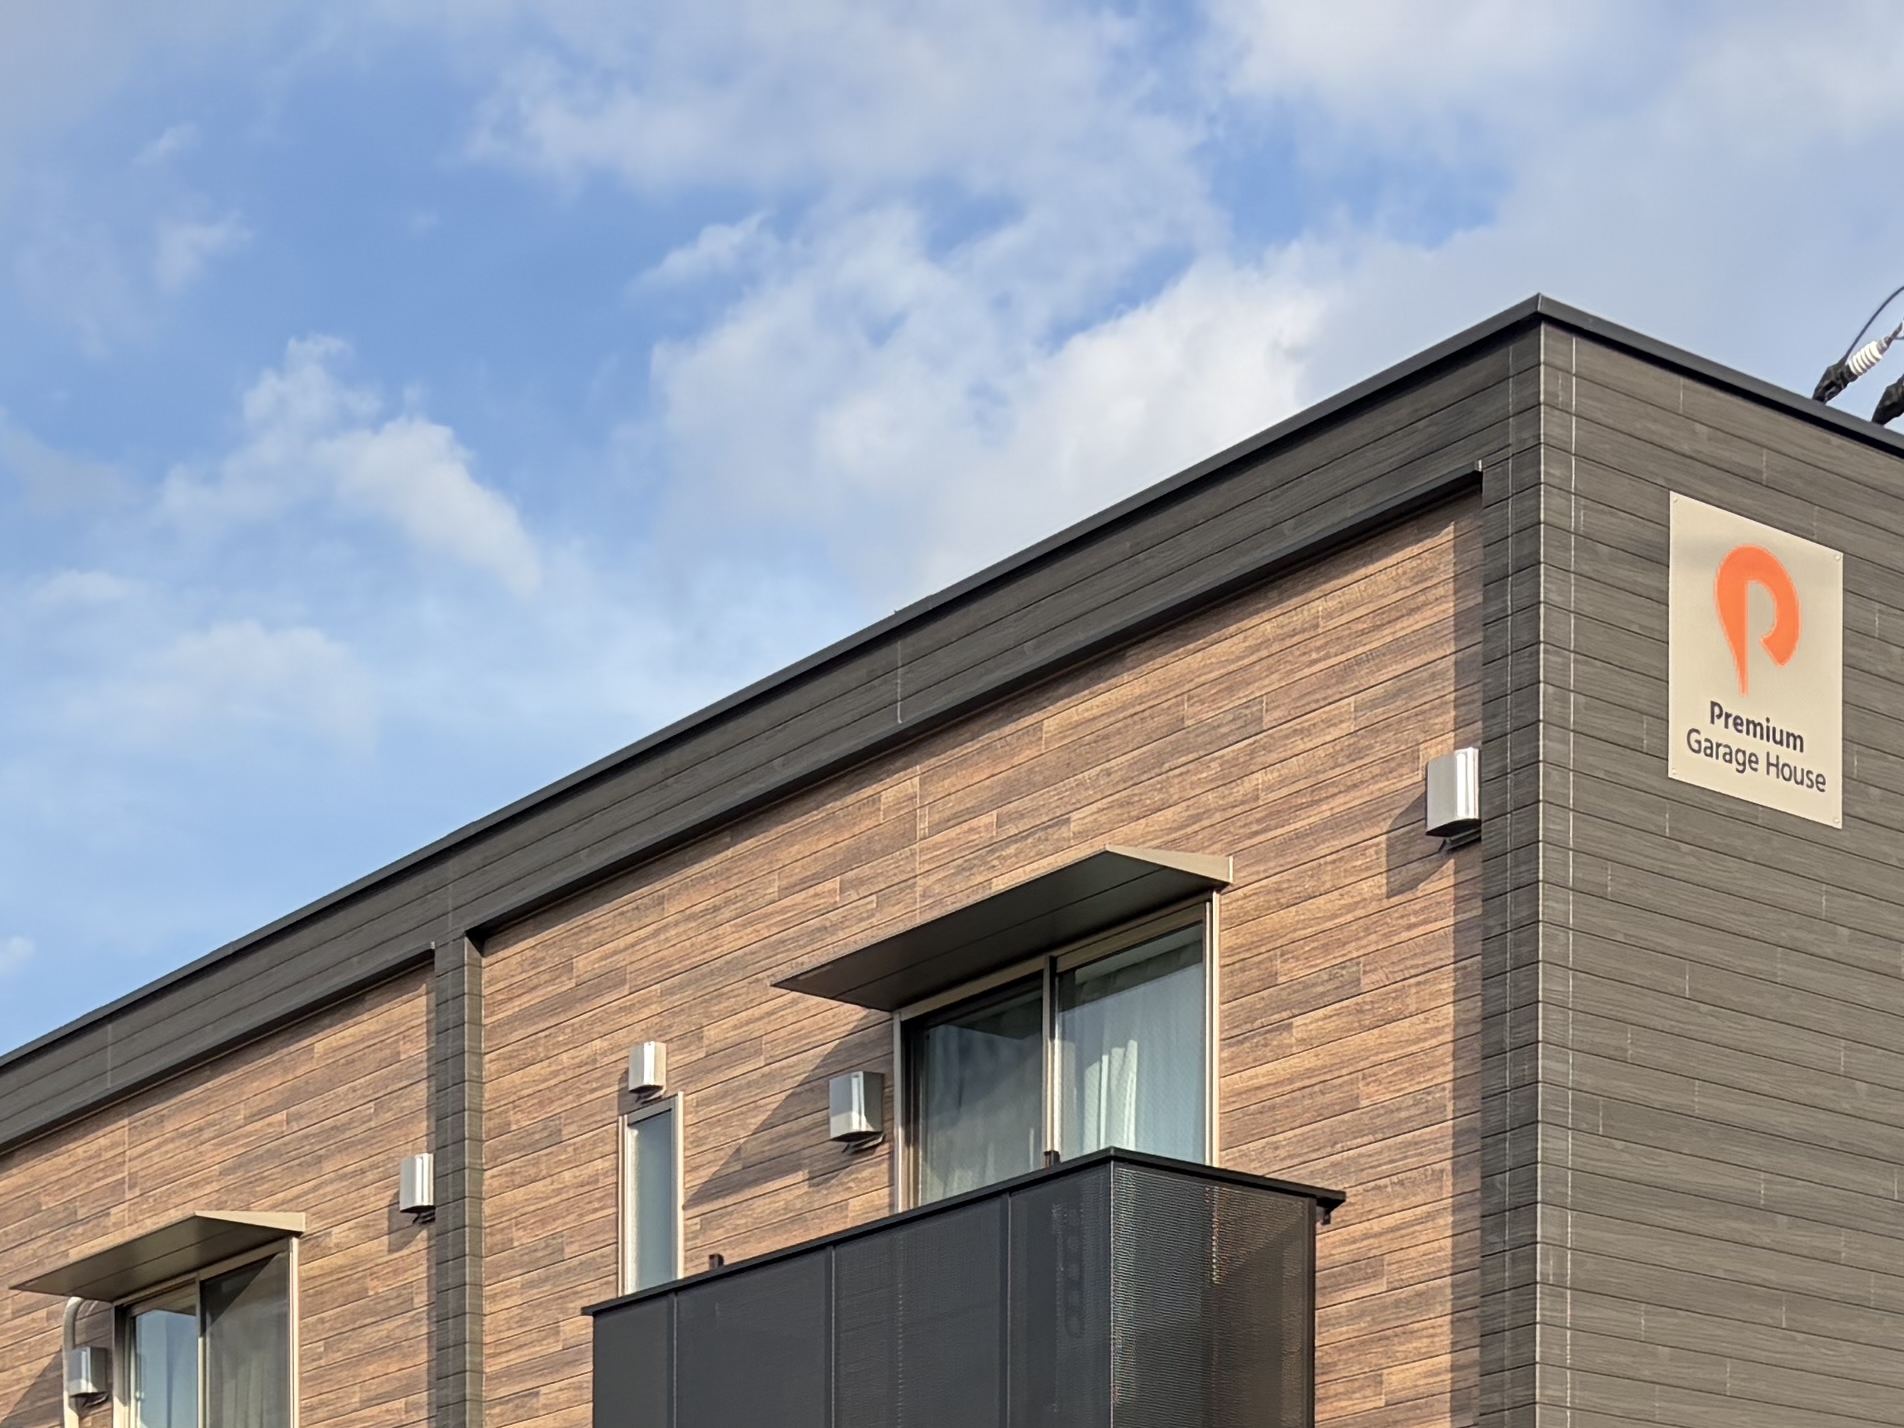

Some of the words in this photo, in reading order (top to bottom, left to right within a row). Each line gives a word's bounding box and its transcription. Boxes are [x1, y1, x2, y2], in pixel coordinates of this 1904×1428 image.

[1709, 699, 1805, 754] Premium
[1685, 727, 1760, 774] Garage
[1765, 750, 1827, 793] House
